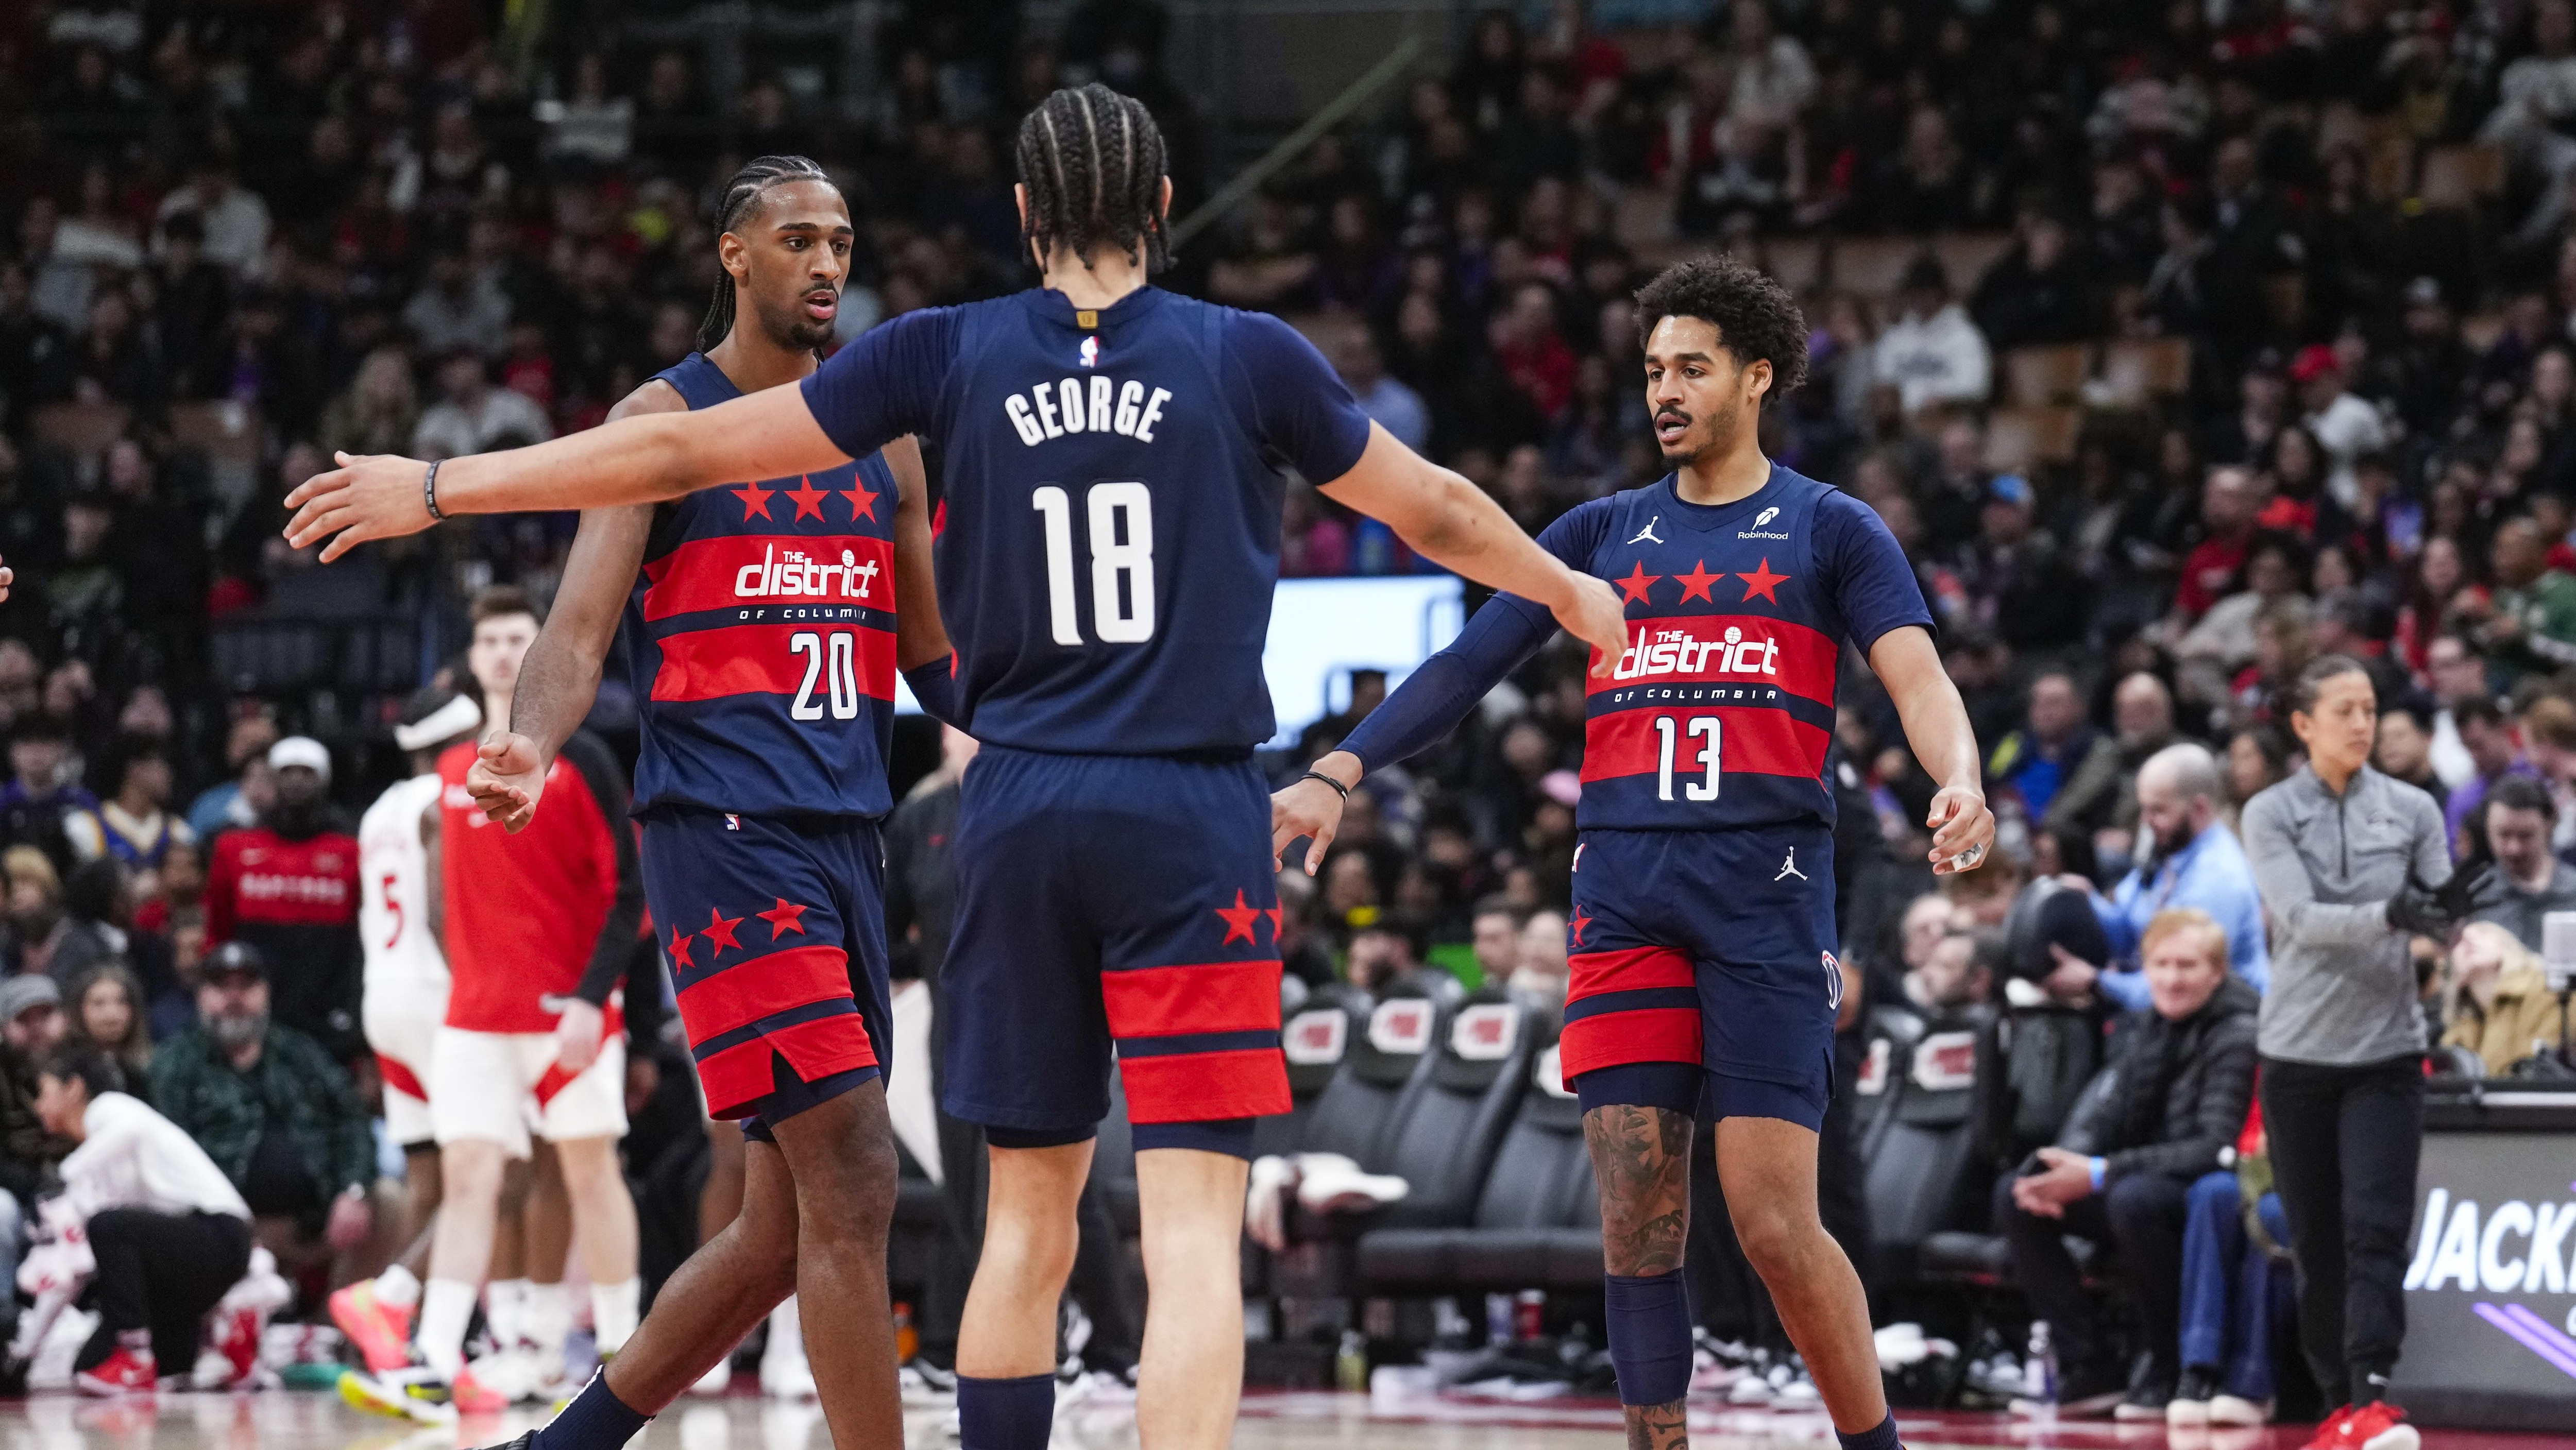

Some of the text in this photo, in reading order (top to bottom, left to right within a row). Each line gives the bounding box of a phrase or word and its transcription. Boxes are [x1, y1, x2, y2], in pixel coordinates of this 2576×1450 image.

[1005, 376, 1172, 447] GEORGE
[783, 551, 805, 563] THE
[1738, 531, 1788, 539] Robinhood
[735, 542, 879, 598] district
[1032, 482, 1155, 646] 18
[739, 609, 866, 620] OF COLUM
[1656, 629, 1684, 643] THE
[790, 632, 858, 720] 20
[1613, 626, 1778, 680] district
[1614, 689, 1776, 703] OF COLUMBIA
[1655, 716, 1722, 801] 13
[382, 874, 404, 948] 5
[2403, 1188, 2576, 1293] JACK
